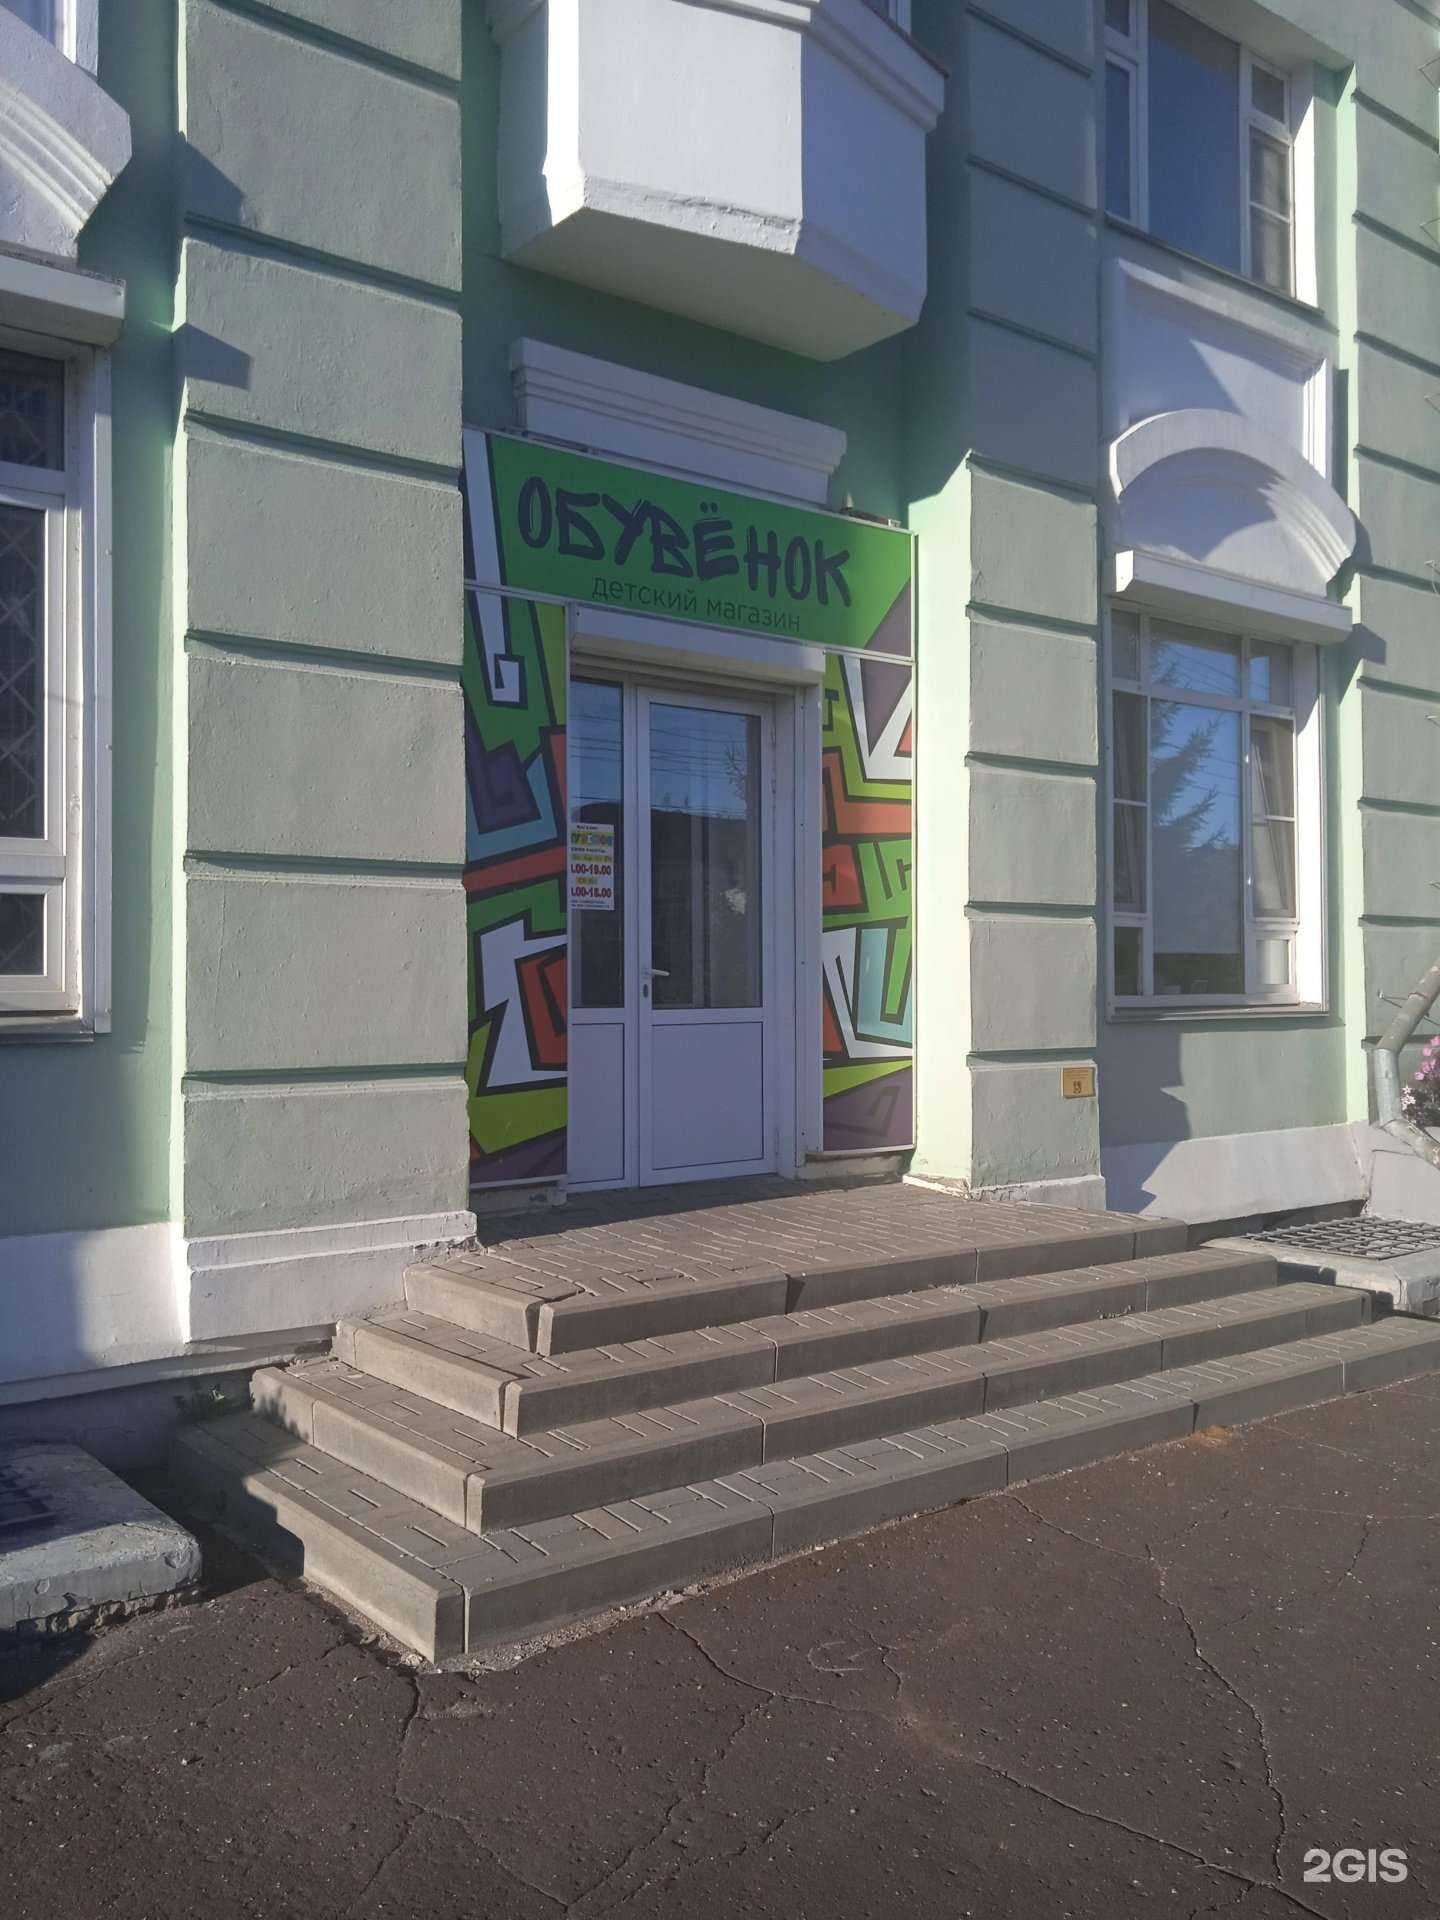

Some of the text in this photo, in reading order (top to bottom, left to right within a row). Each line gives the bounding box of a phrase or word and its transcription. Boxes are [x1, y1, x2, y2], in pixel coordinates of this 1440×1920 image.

[518, 476, 851, 607] ОБУВЁНОК
[592, 577, 800, 632] детский магазин
